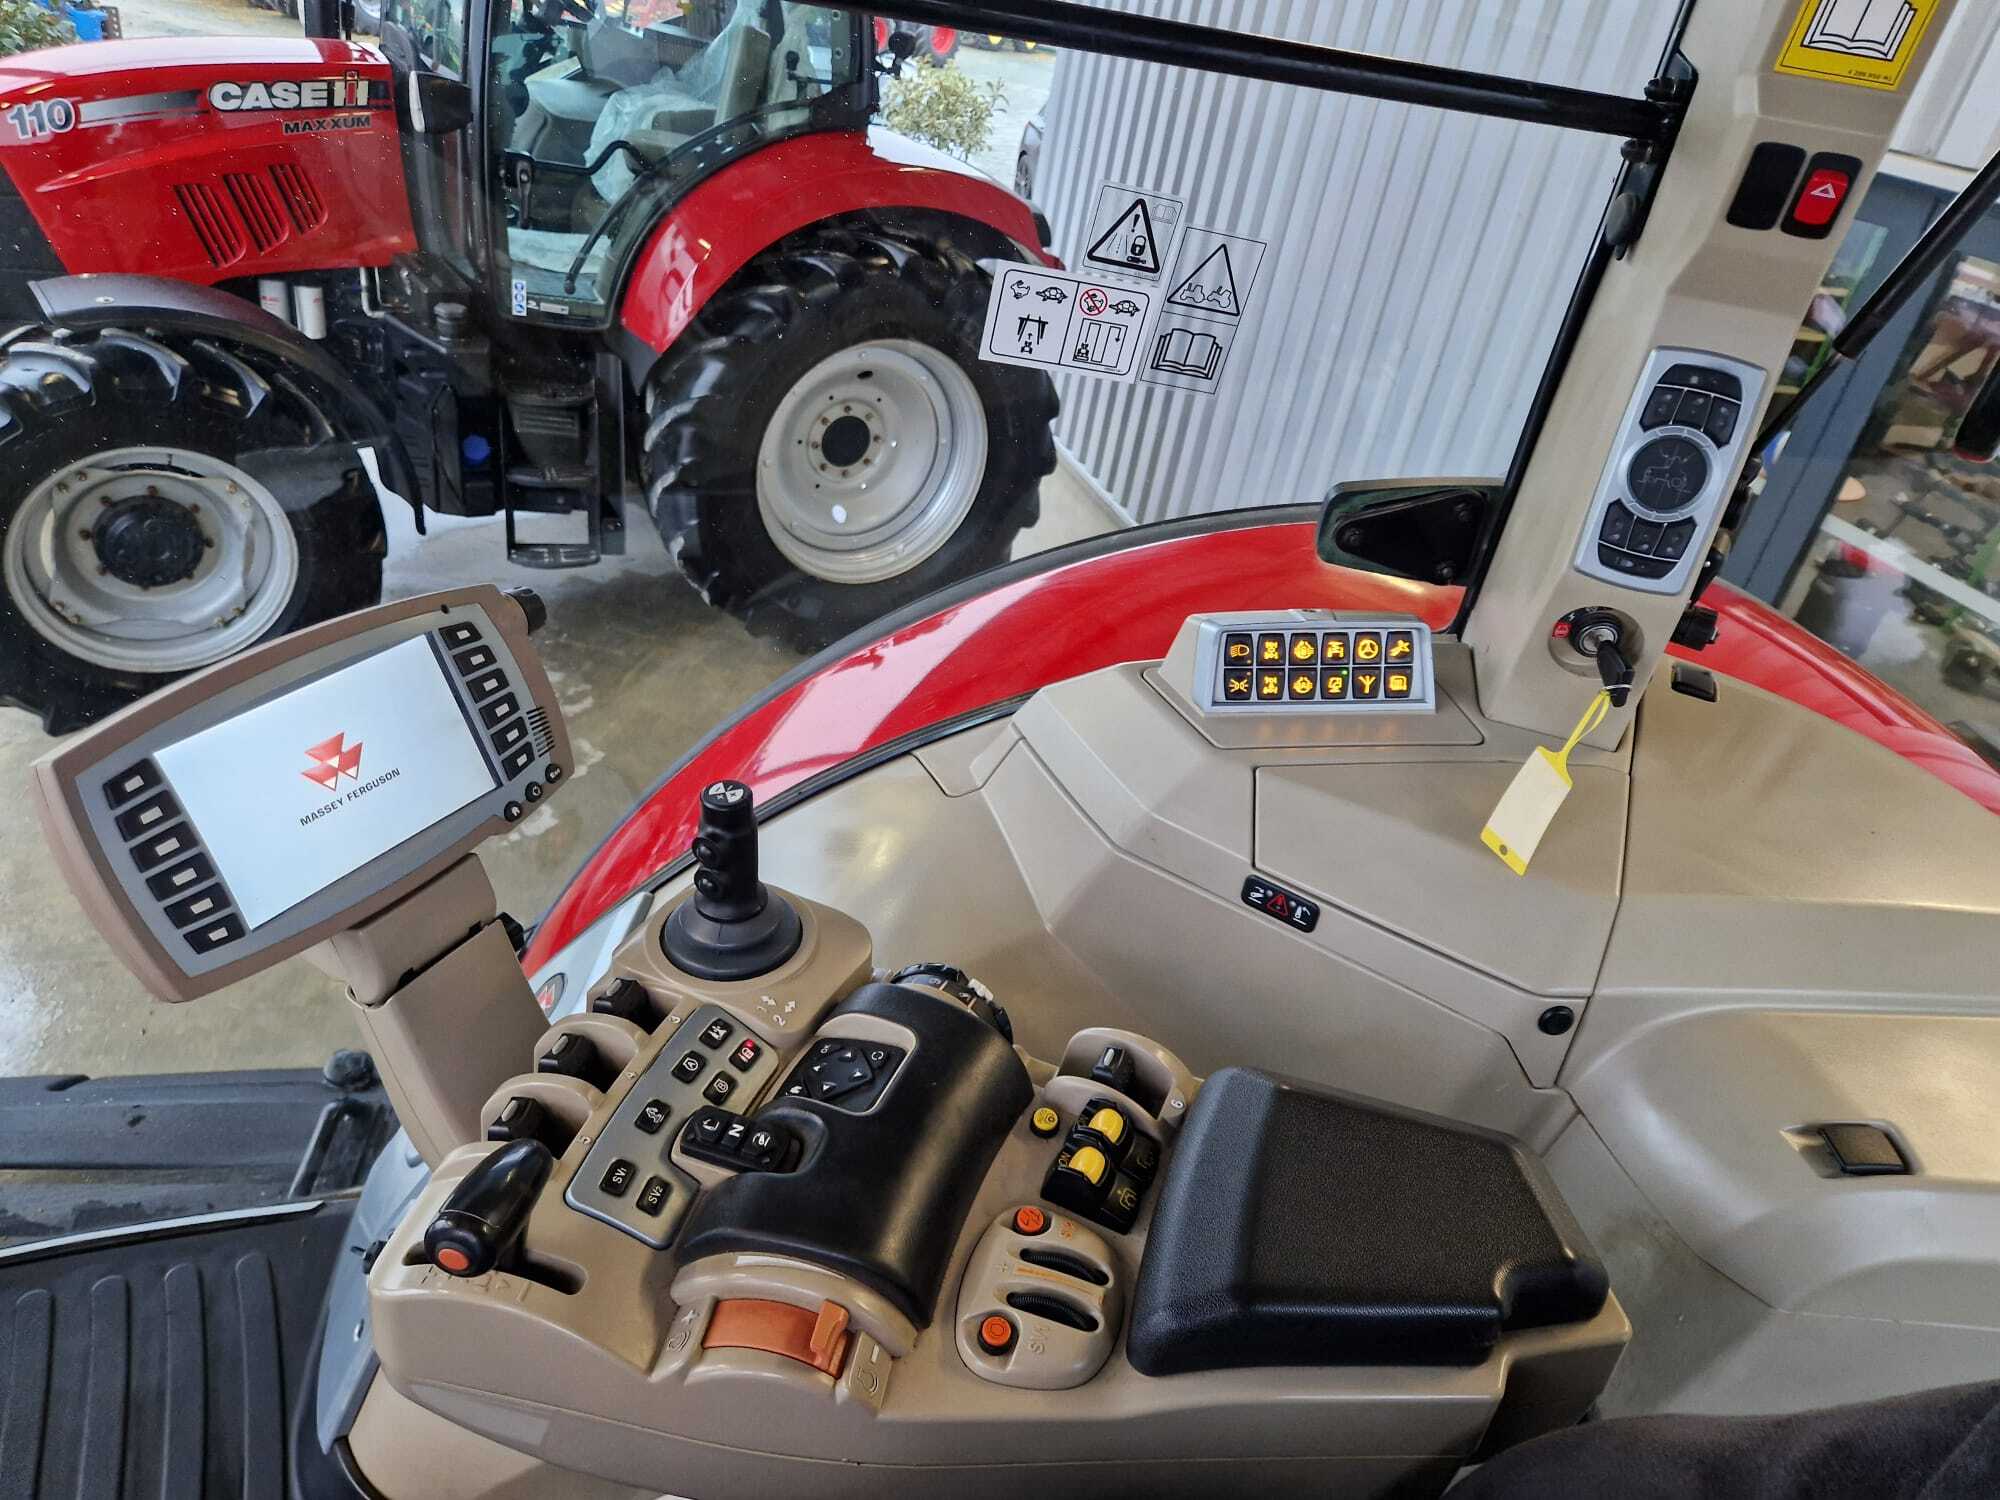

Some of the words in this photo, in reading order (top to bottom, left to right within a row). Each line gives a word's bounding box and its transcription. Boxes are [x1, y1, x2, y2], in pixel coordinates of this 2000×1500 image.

[209, 82, 328, 111] CASE
[7, 98, 76, 139] 110
[284, 116, 371, 134] MAXXUM
[299, 798, 344, 827] MASSEY
[346, 767, 401, 802] FERGUSON
[728, 1123, 744, 1138] N
